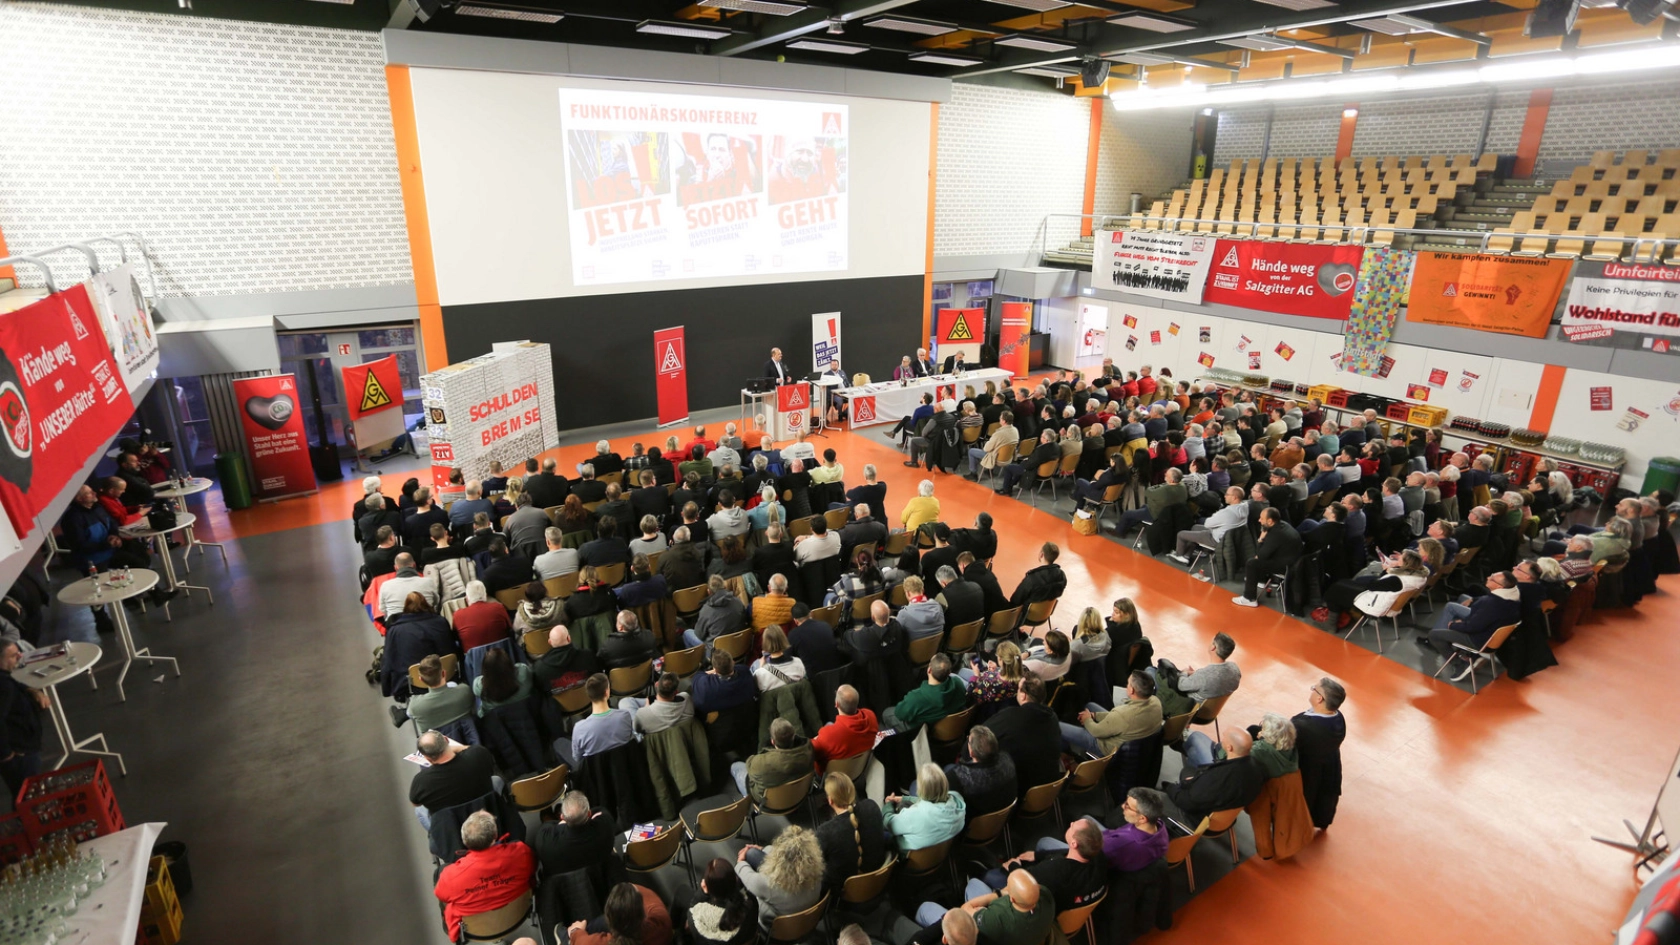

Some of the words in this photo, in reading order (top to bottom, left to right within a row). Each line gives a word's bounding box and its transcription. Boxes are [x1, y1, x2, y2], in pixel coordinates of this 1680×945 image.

[570, 102, 758, 126] FUNKTIONÄRSKONFERENZ
[685, 197, 759, 230] SOFORT
[777, 196, 839, 229] GEHT
[583, 198, 662, 247] JETZT
[1251, 257, 1289, 274] Hände
[1289, 262, 1316, 278] weg
[1434, 252, 1450, 260] Wir
[1451, 253, 1491, 263] kämpfen
[1493, 255, 1550, 267] zusammen!
[1281, 273, 1292, 282] der
[1244, 280, 1296, 296] Salzgitter
[1296, 284, 1314, 296] AG
[1585, 285, 1611, 295] Keine
[1612, 286, 1662, 298] Privilegien
[1663, 290, 1679, 299] für
[1569, 304, 1657, 326] Wohlstand
[19, 345, 58, 388] Hände
[53, 340, 77, 367] weg
[429, 388, 442, 400] 32
[469, 381, 538, 423] SCHULDEN
[252, 434, 271, 443] Unser
[271, 432, 287, 440] Herz
[253, 441, 271, 450] Stahl
[271, 438, 283, 447] hat
[283, 437, 297, 445] eine
[255, 448, 275, 458] grüne
[480, 874, 502, 884] Team
